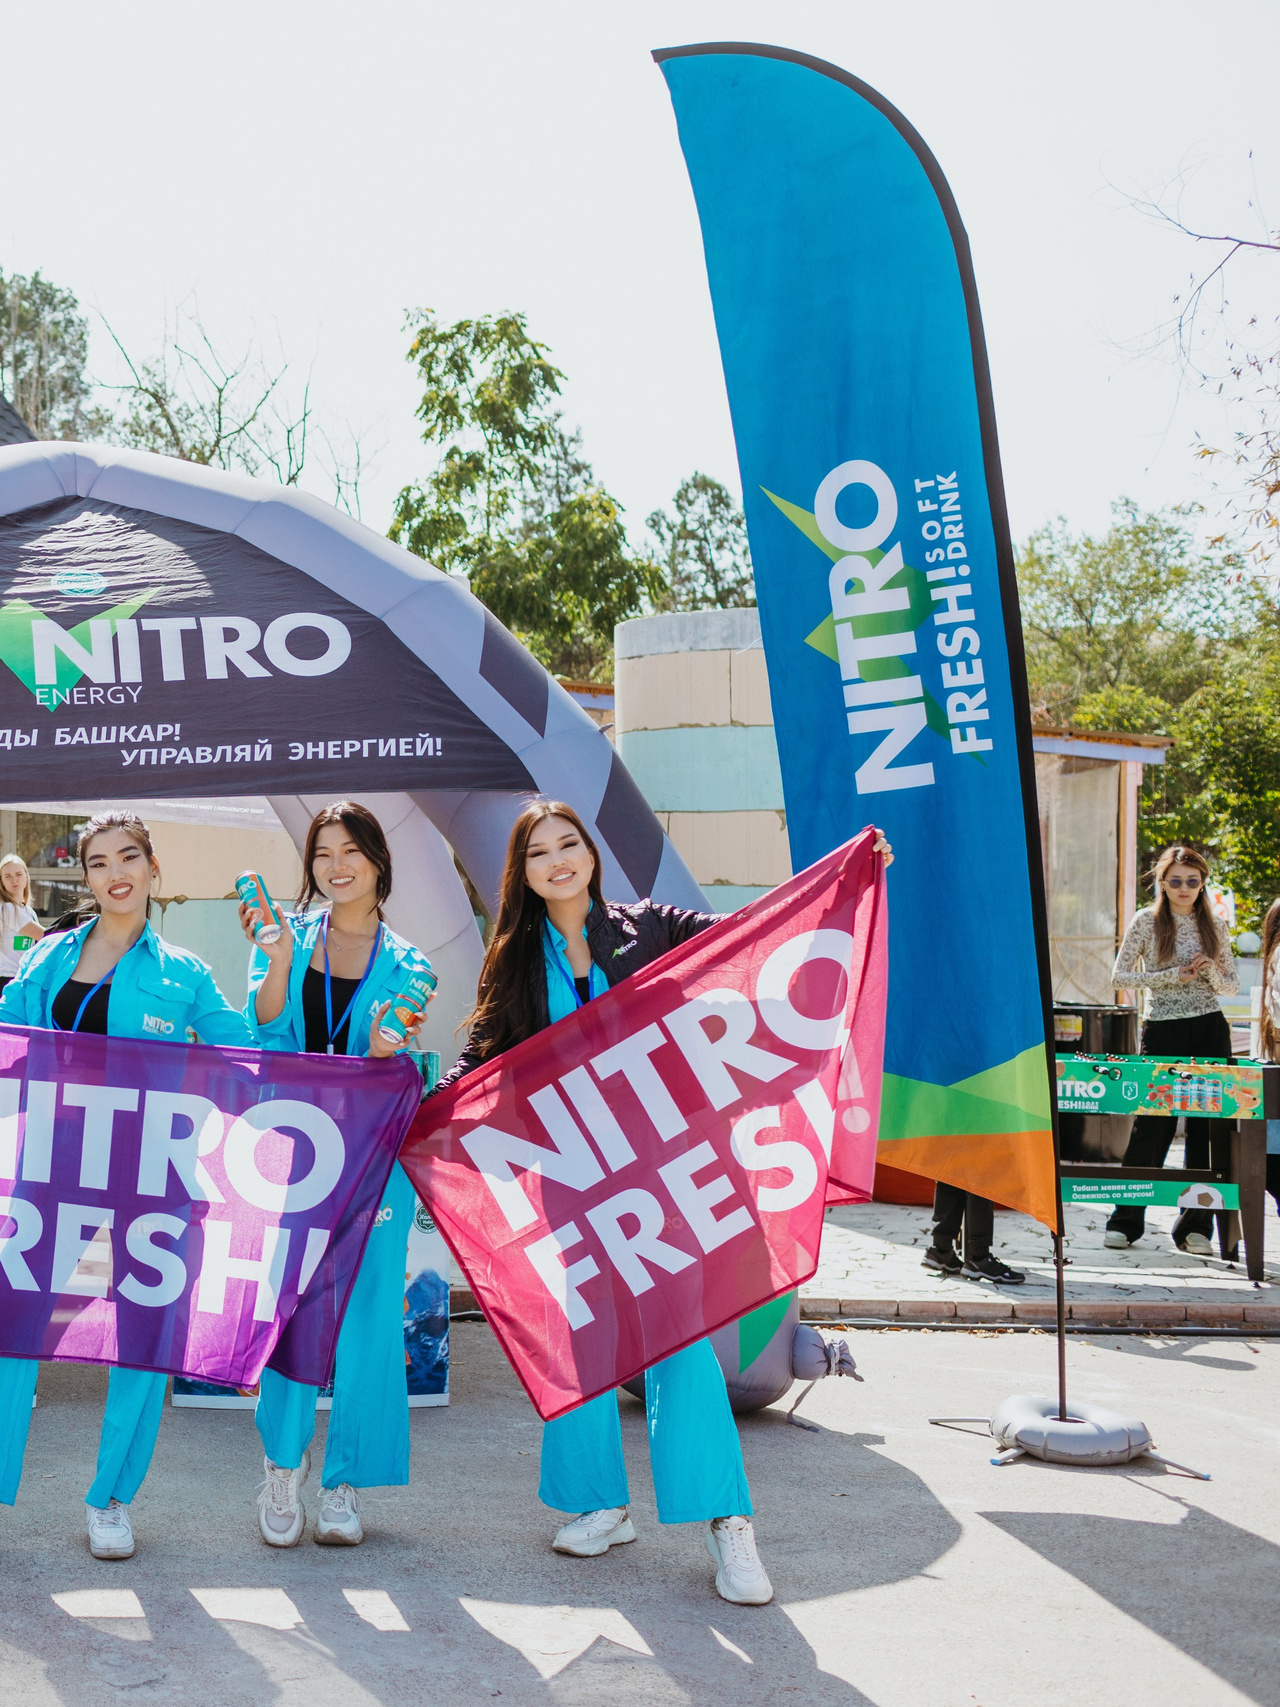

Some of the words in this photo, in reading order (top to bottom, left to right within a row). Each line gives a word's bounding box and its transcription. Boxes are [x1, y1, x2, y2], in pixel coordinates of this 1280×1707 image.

[936, 470, 967, 559] DRINK
[814, 459, 935, 794] NITRO
[31, 612, 352, 685] NITRO
[925, 563, 993, 754] FRESH!
[35, 685, 143, 706] ENERGY
[54, 723, 181, 745] БАШКАР!
[121, 739, 272, 766] УПРАВЛЯЙ
[288, 732, 443, 760] ЭНЕРГИЕЙ!
[143, 1013, 175, 1035] NITRO
[459, 928, 854, 1233] NITRO
[1057, 1080, 1106, 1099] ITRO
[1058, 1100, 1082, 1110] ESH!
